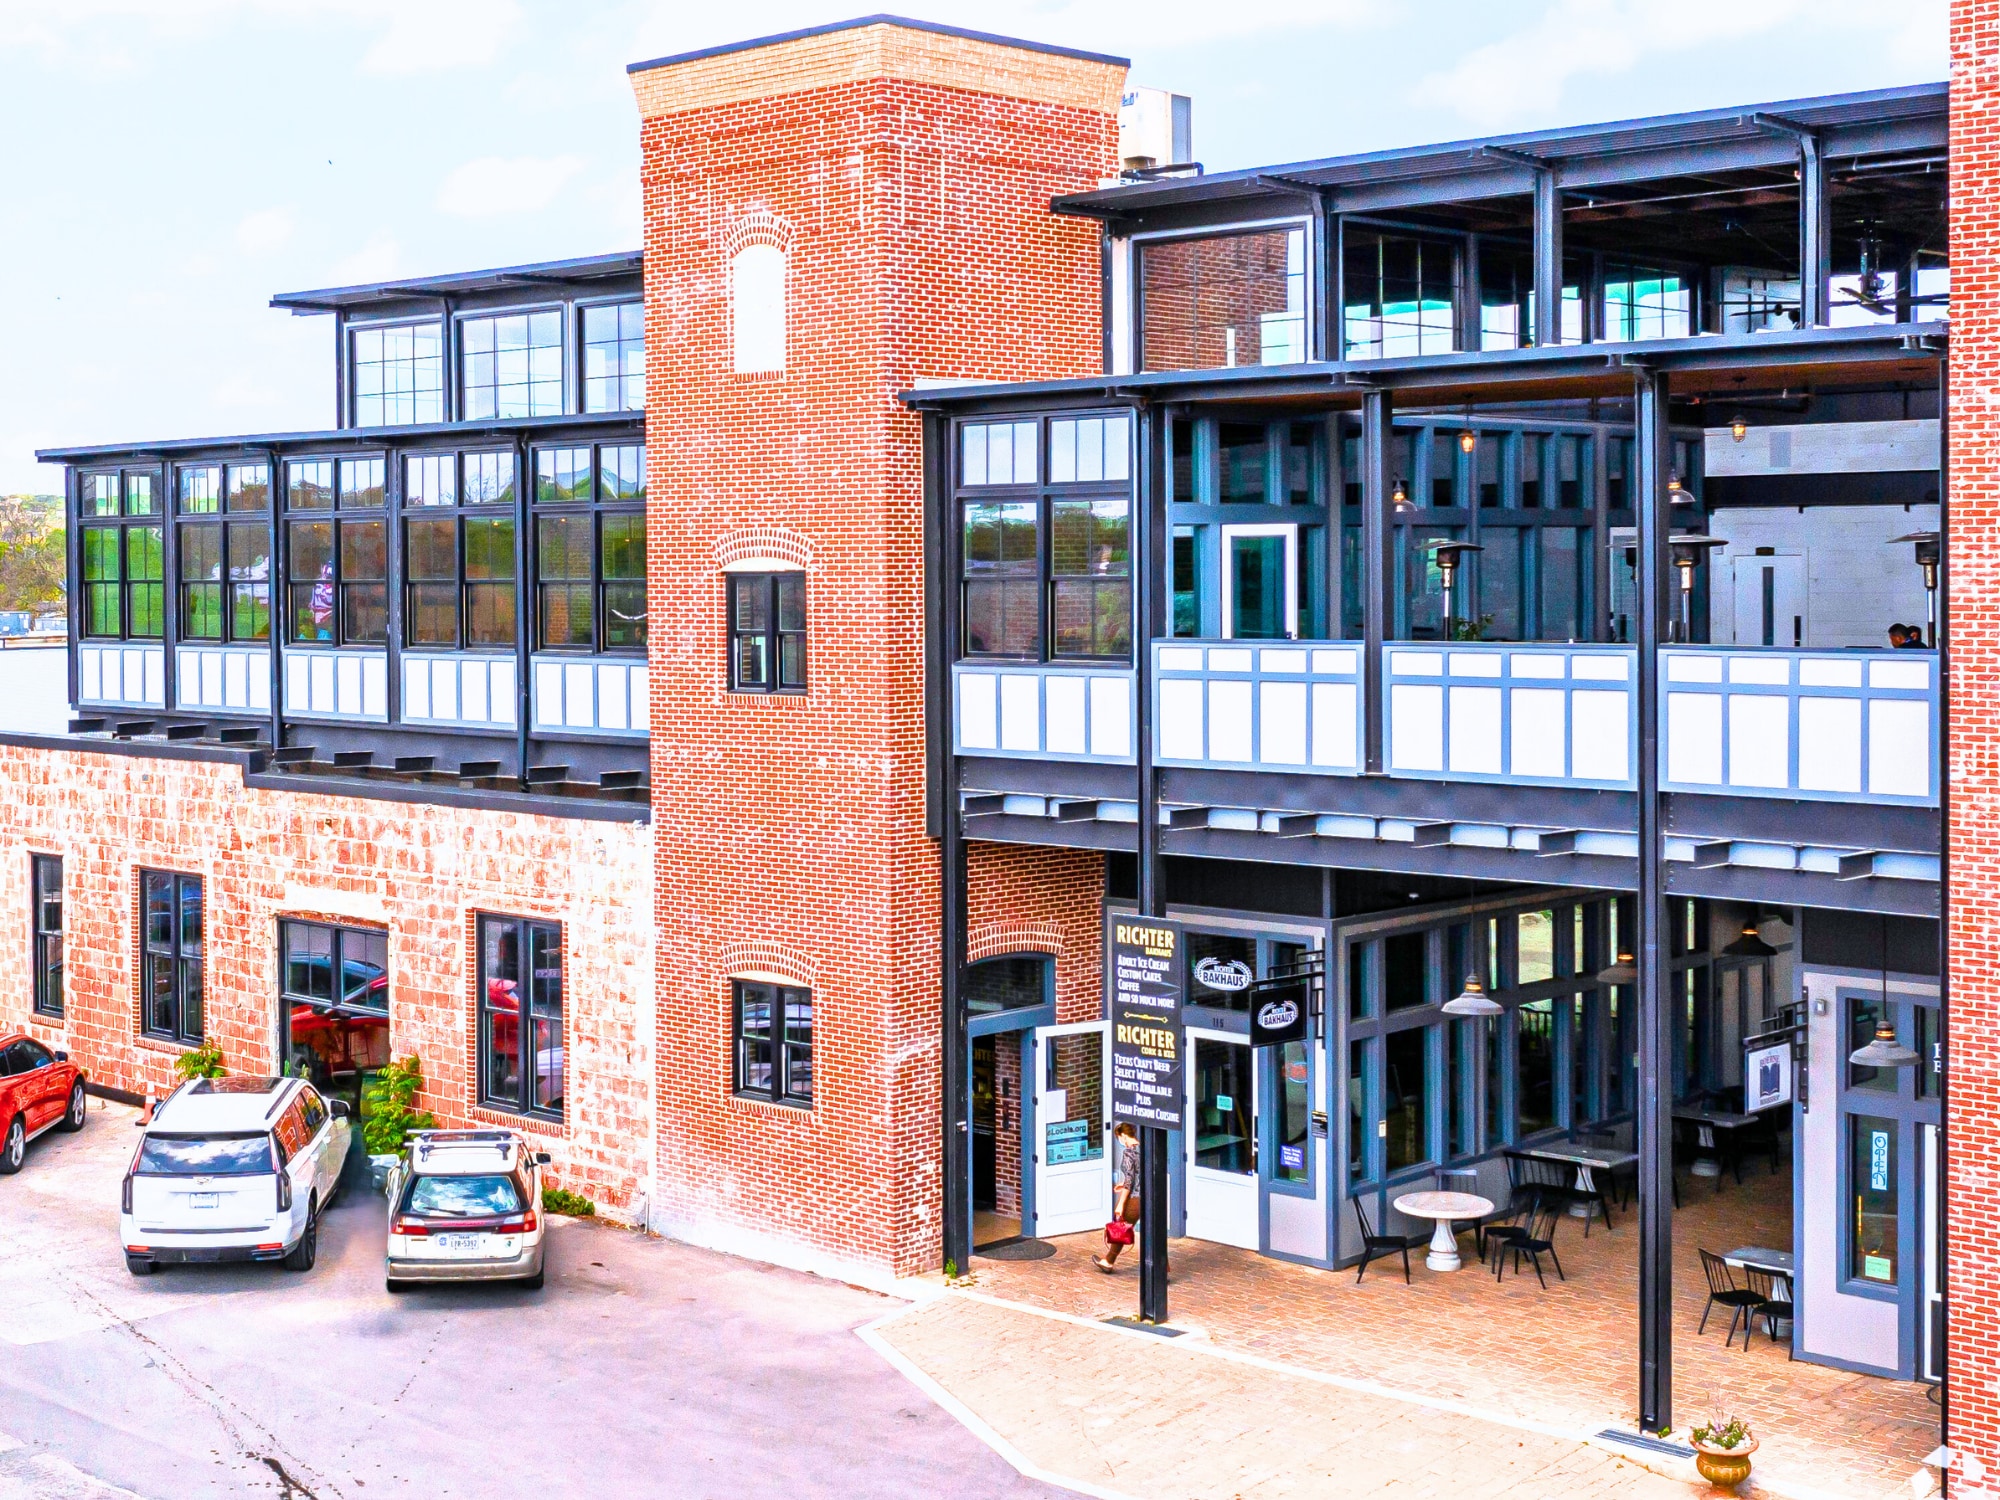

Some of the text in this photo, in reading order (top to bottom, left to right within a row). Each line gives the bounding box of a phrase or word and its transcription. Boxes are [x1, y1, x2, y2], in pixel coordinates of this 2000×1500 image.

[1117, 925, 1175, 949] RICHTER
[1137, 957, 1148, 969] ICE
[1148, 958, 1170, 972] CREAM
[1117, 966, 1162, 982] CUSTOM CAKES
[1117, 978, 1140, 992] COFFEE
[1157, 997, 1175, 1009] MORE
[1117, 1024, 1175, 1049] RICHTER
[1141, 1046, 1156, 1057] CORK
[1114, 1053, 1171, 1072] TEXAS CRAFT BEER
[1114, 1065, 1157, 1083] SELECT WINES
[1114, 1078, 1173, 1097] FLIGHTS AVAILABLE
[1135, 1092, 1152, 1106] PLUS
[1114, 1101, 1180, 1123] ASIAN FUSION CUISINE
